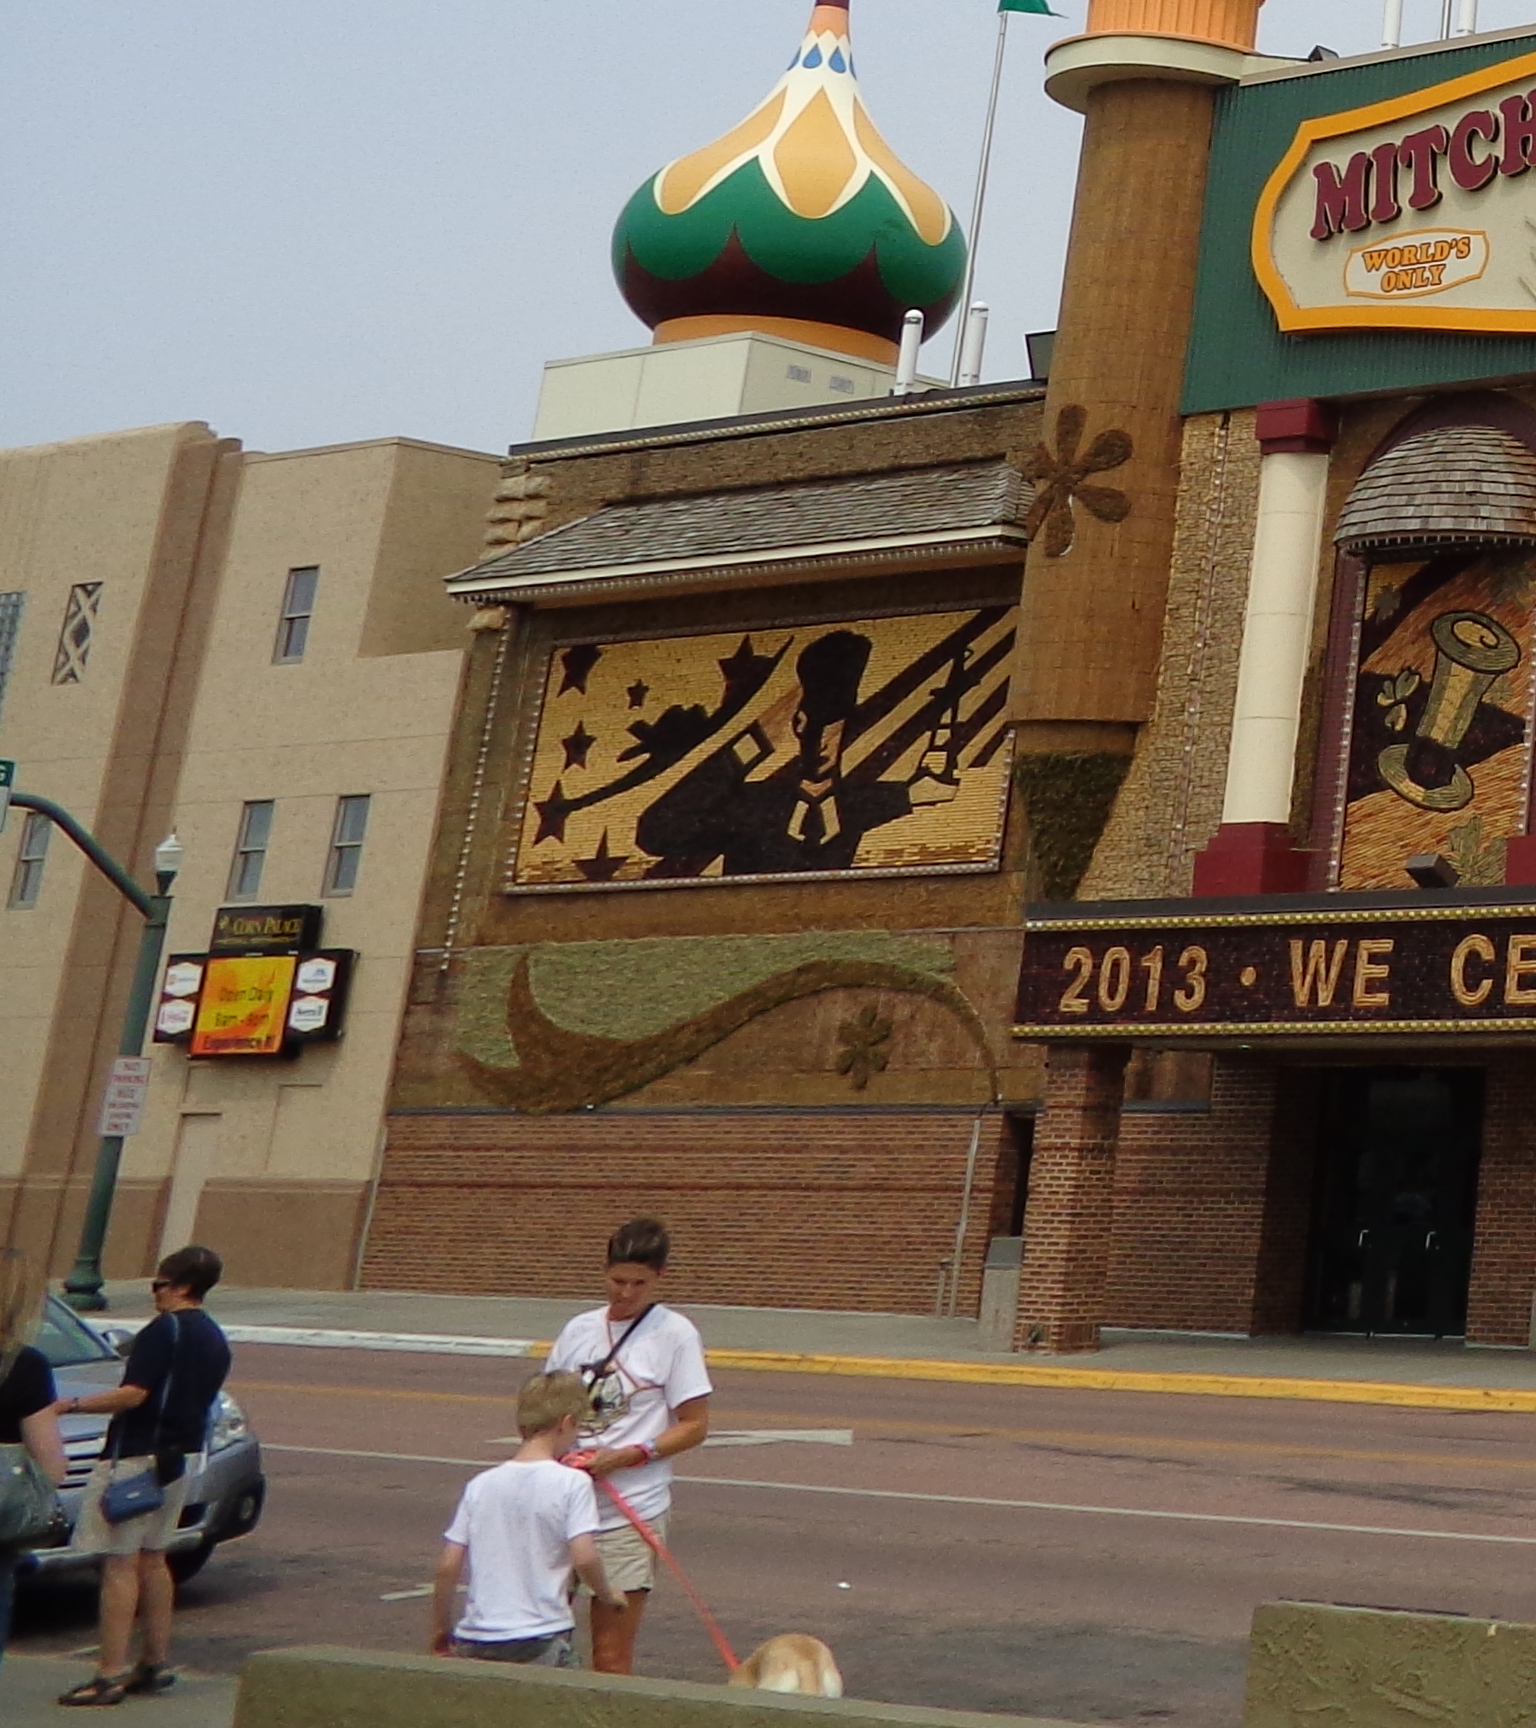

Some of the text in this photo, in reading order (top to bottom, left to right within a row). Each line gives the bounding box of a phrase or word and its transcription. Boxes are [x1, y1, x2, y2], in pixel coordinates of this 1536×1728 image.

[1361, 235, 1472, 273] WORLD'S
[1380, 264, 1447, 294] ONLY
[1058, 944, 1209, 1015] 2013
[1288, 938, 1395, 1008] WE
